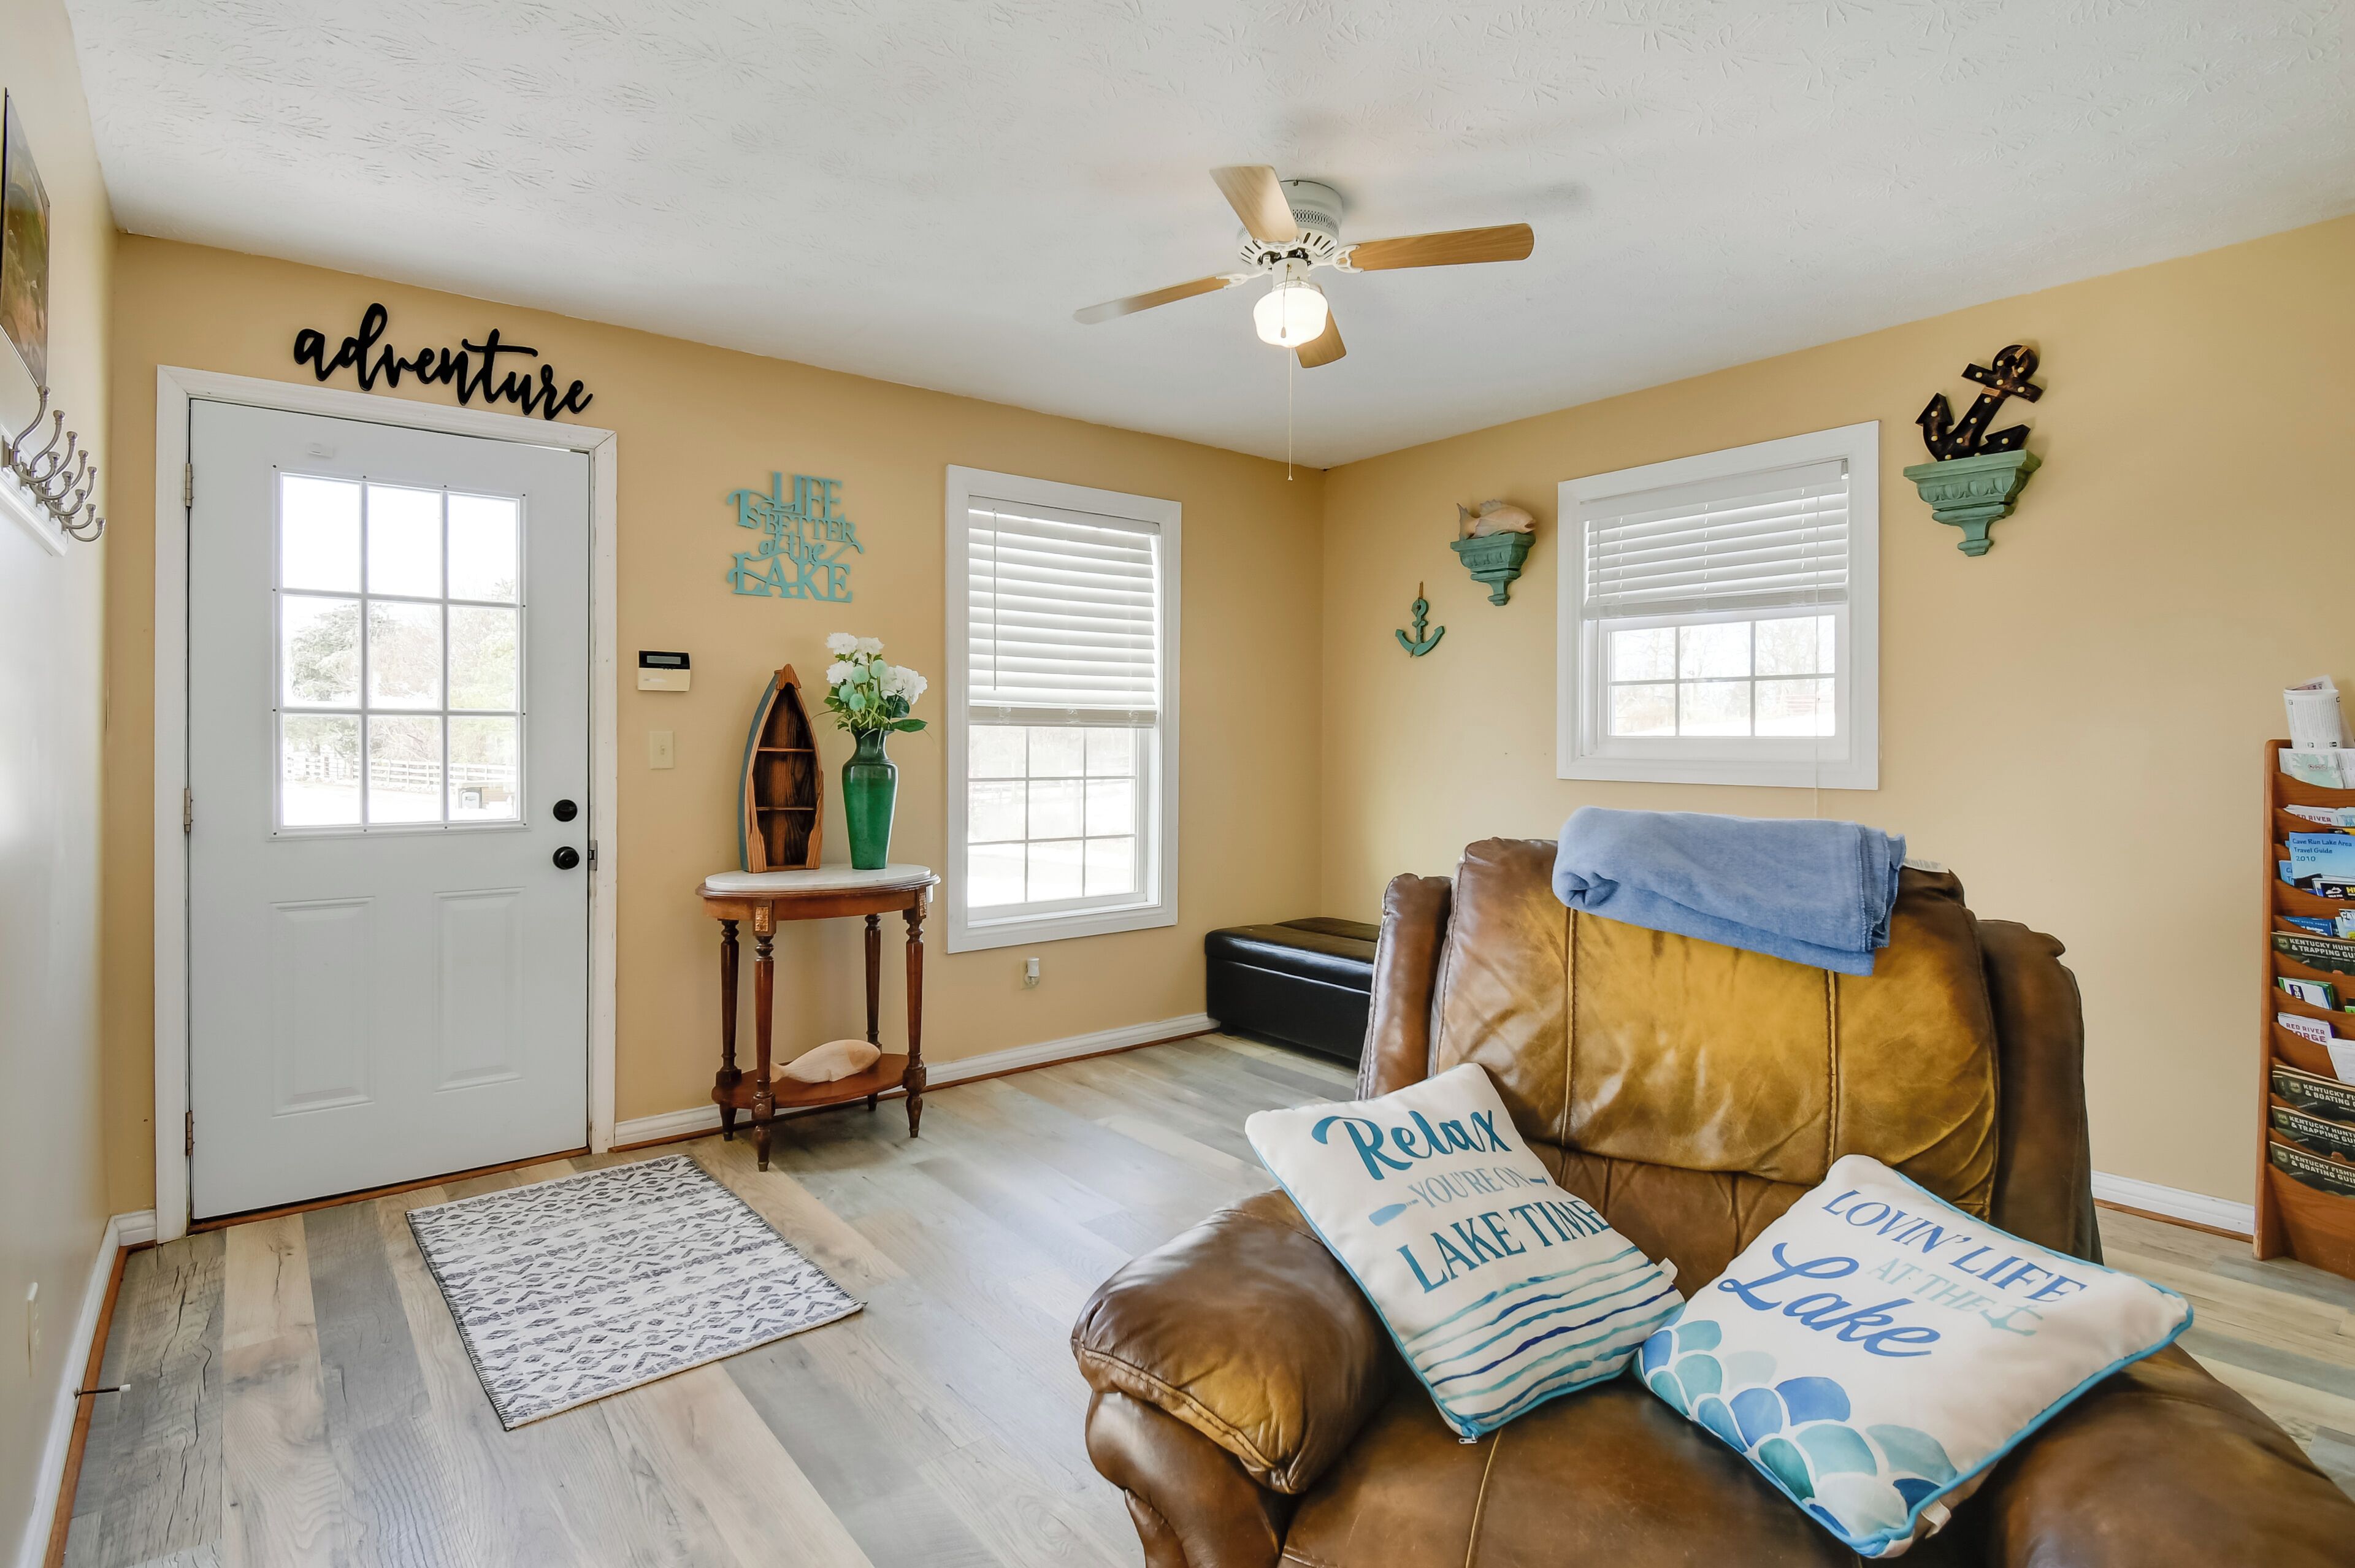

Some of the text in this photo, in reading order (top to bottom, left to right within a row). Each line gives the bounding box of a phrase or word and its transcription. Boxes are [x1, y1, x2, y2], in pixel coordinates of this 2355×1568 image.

[293, 302, 593, 421] adventure
[772, 472, 843, 521] LIFE
[764, 512, 861, 548] BETTER
[788, 531, 827, 564] the
[727, 552, 853, 603] LAKE
[2289, 938, 2330, 948] KENTUCKY
[2299, 946, 2340, 956] TRAPPING
[2296, 1031, 2326, 1042] ORGE
[2302, 1026, 2325, 1034] RIVER
[2303, 1084, 2344, 1098] KENTUCKY
[2313, 1092, 2350, 1106] BOATING
[2289, 1116, 2329, 1131] KENTUCKY
[2298, 1124, 2340, 1140] TRAPPING
[1311, 1109, 1512, 1180] Relax
[2289, 1153, 2329, 1170] KENTUCKY
[2299, 1163, 2335, 1178] BOATING
[1407, 1166, 1534, 1209] YOU'RE ON
[1396, 1199, 1612, 1293] LAKE TIME
[1821, 1189, 2088, 1302] LOVIN' LIFE
[1717, 1242, 1941, 1357] Lake
[1866, 1257, 1987, 1312] AT THE
